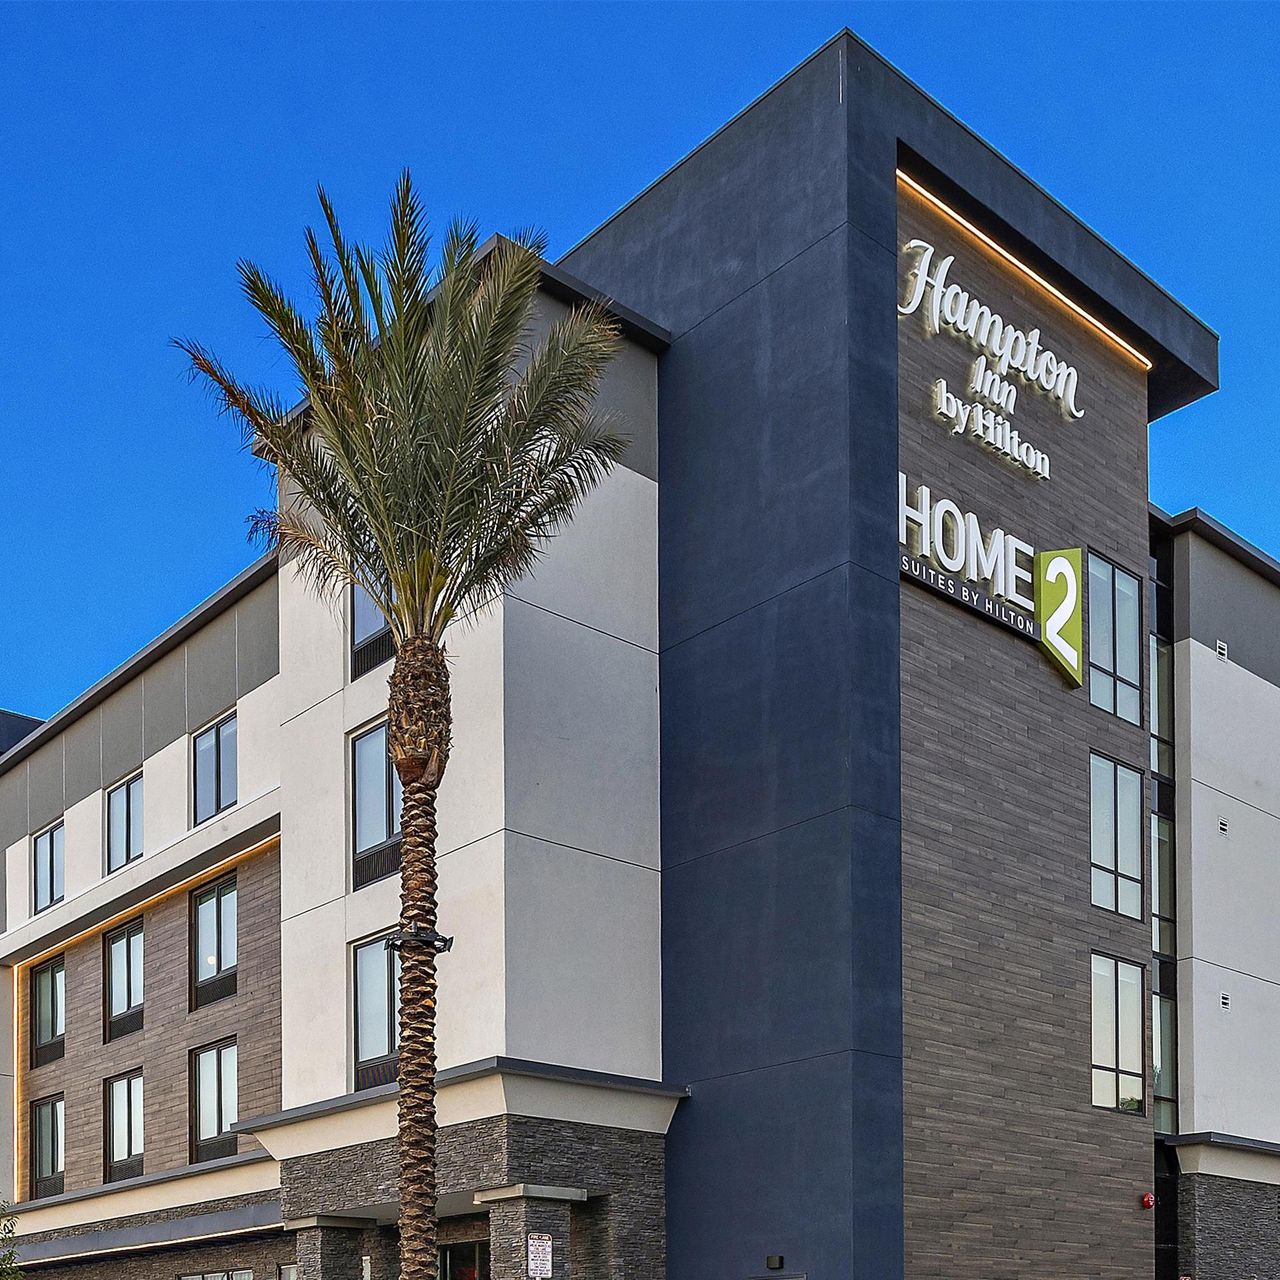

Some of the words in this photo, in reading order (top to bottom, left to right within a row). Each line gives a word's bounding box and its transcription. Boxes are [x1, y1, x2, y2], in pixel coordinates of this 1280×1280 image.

[897, 239, 1085, 419] Hampton
[936, 378, 971, 434] by
[971, 402, 1051, 480] Hilton
[971, 355, 1018, 415] Inn
[899, 471, 1035, 612] HOME
[1045, 556, 1078, 671] 2
[901, 555, 955, 594] SUITES
[961, 589, 980, 606] BY
[985, 598, 1034, 635] HILTON
